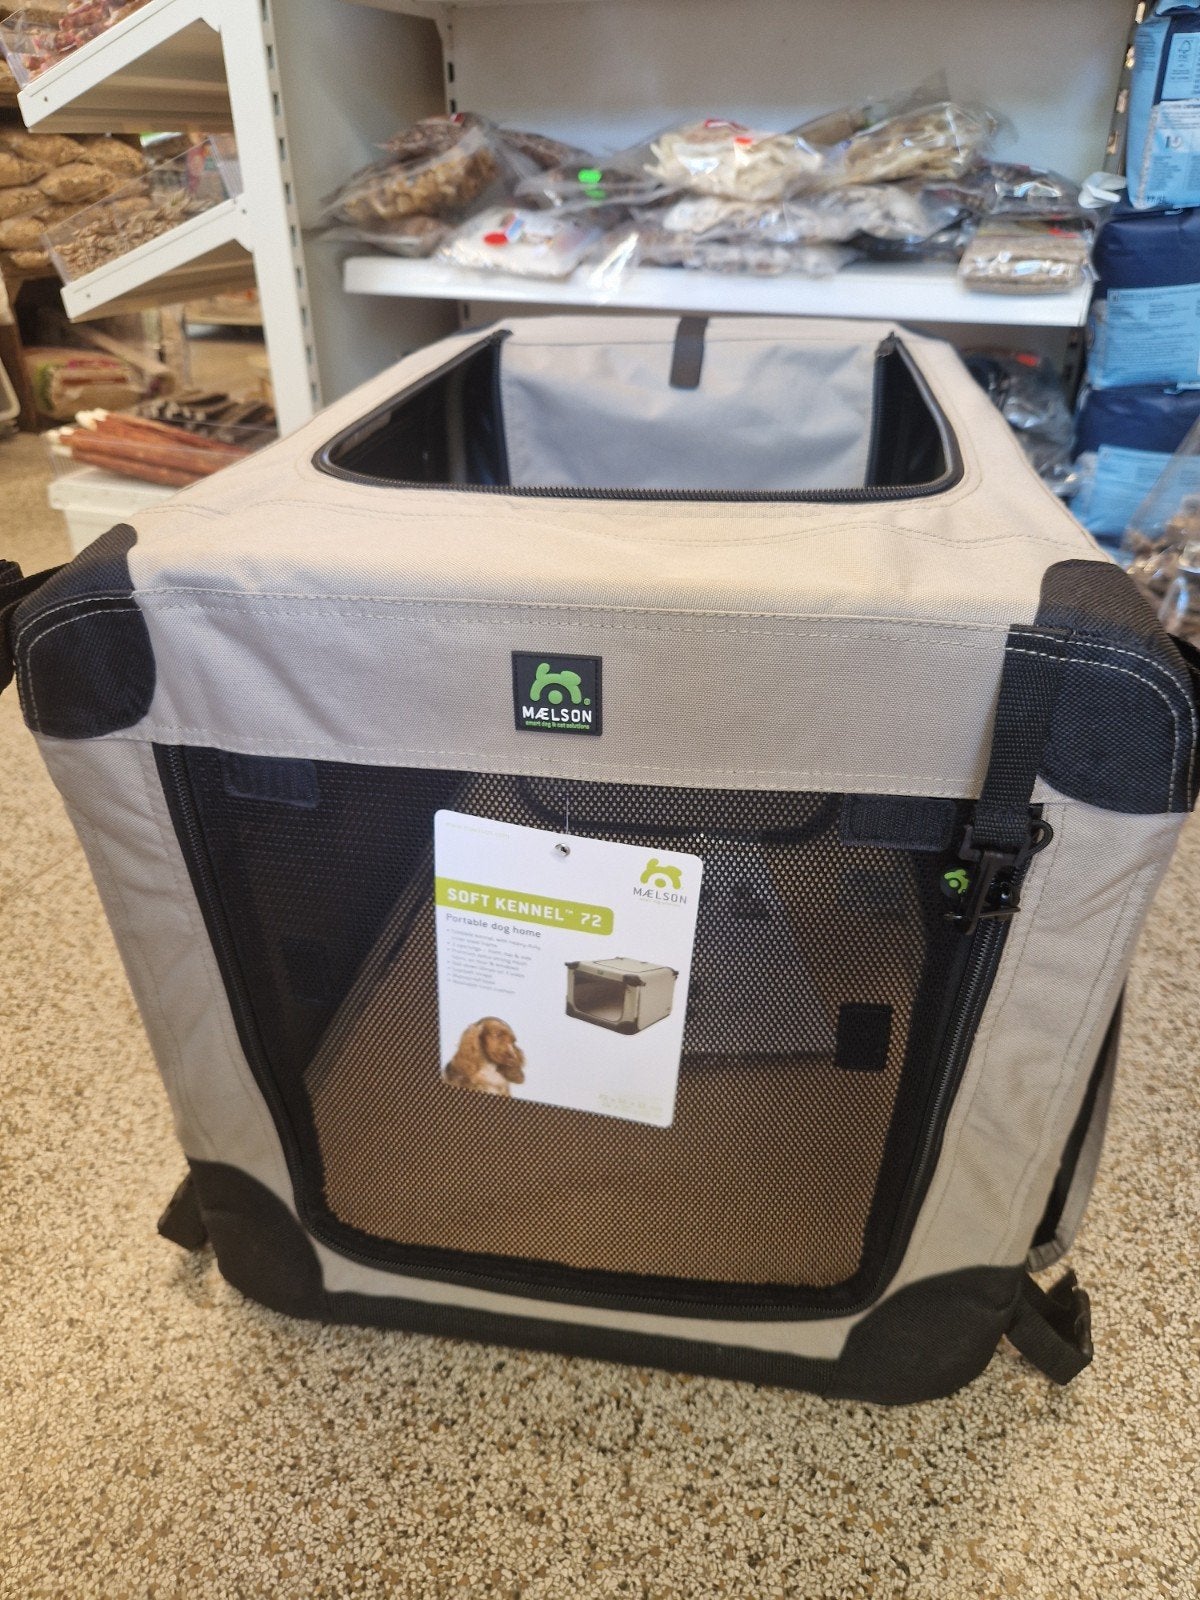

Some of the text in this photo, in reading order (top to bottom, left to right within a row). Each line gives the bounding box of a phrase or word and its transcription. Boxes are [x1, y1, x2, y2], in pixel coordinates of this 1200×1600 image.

[522, 705, 592, 723] MÆLSON
[633, 887, 687, 904] MÆLSON
[447, 887, 490, 907] SOFT
[580, 912, 602, 927] 72
[446, 913, 542, 938] Portable dog home
